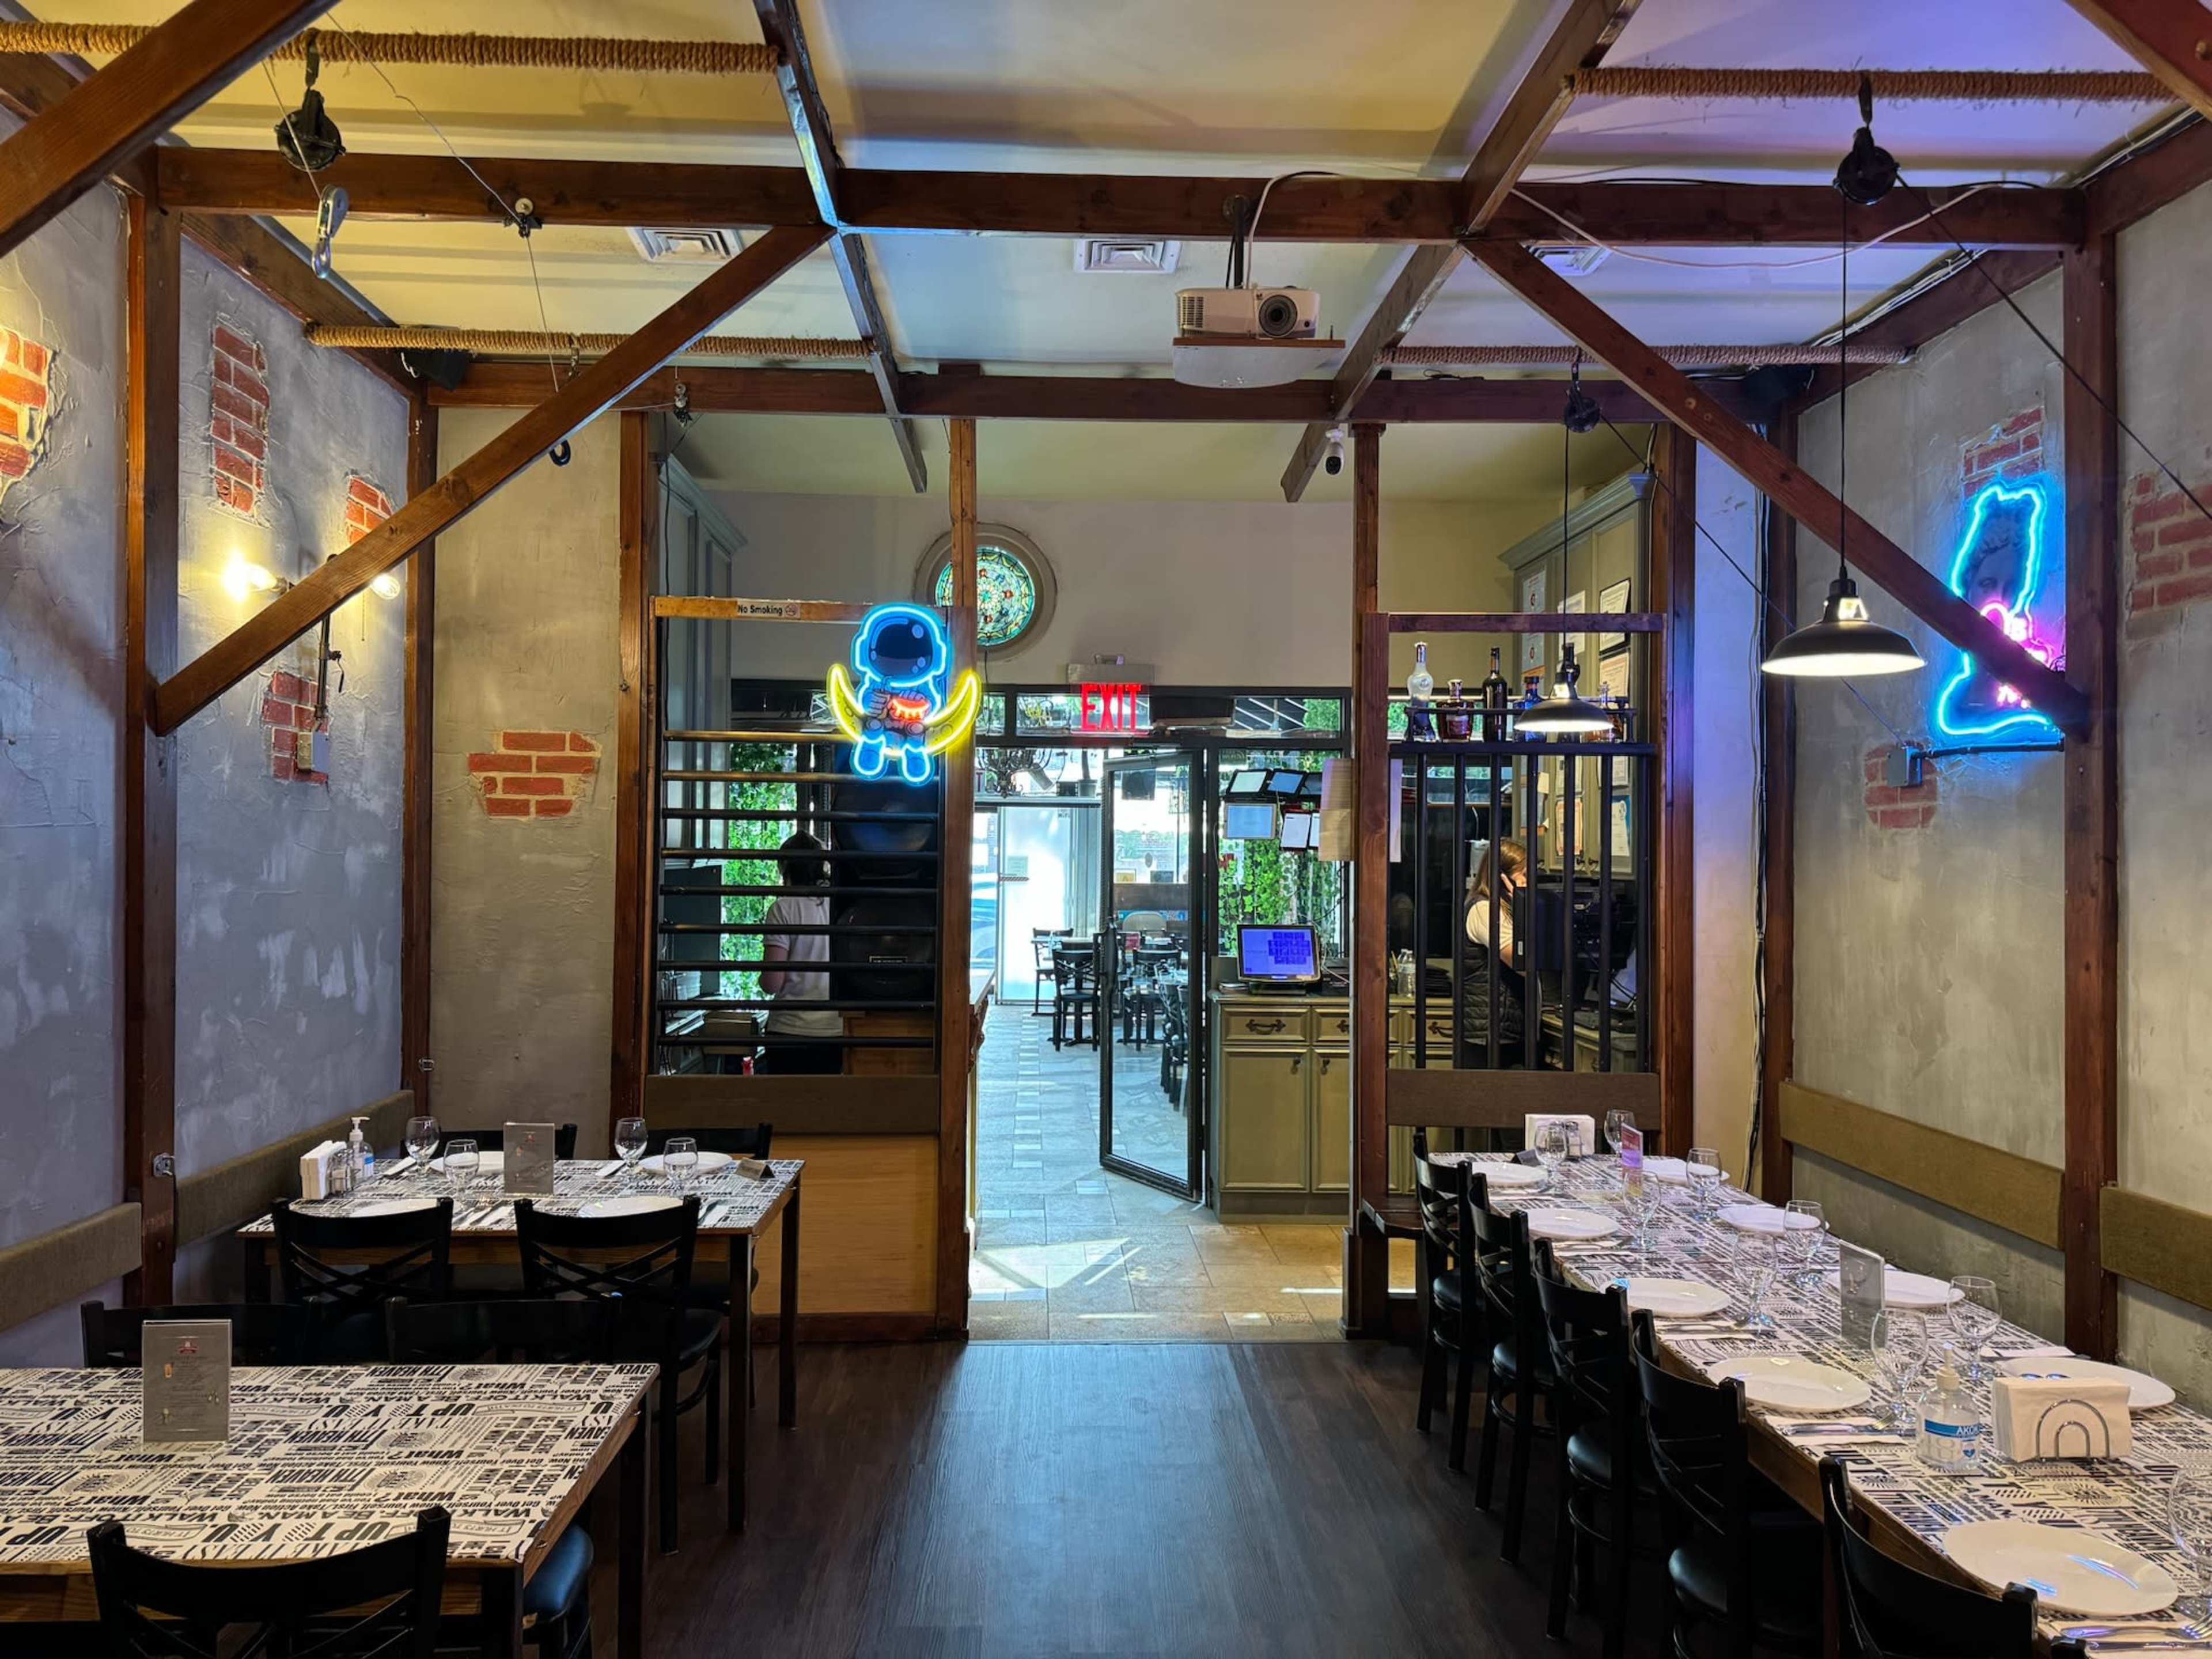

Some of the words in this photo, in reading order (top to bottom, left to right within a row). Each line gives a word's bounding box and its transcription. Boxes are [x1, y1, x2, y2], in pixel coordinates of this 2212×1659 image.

[737, 605, 748, 613] No
[750, 605, 783, 616] Smoking
[1081, 682, 1141, 732] EXIT
[431, 1403, 475, 1416] UP
[6, 1526, 69, 1545] UP
[334, 1522, 390, 1540] UP
